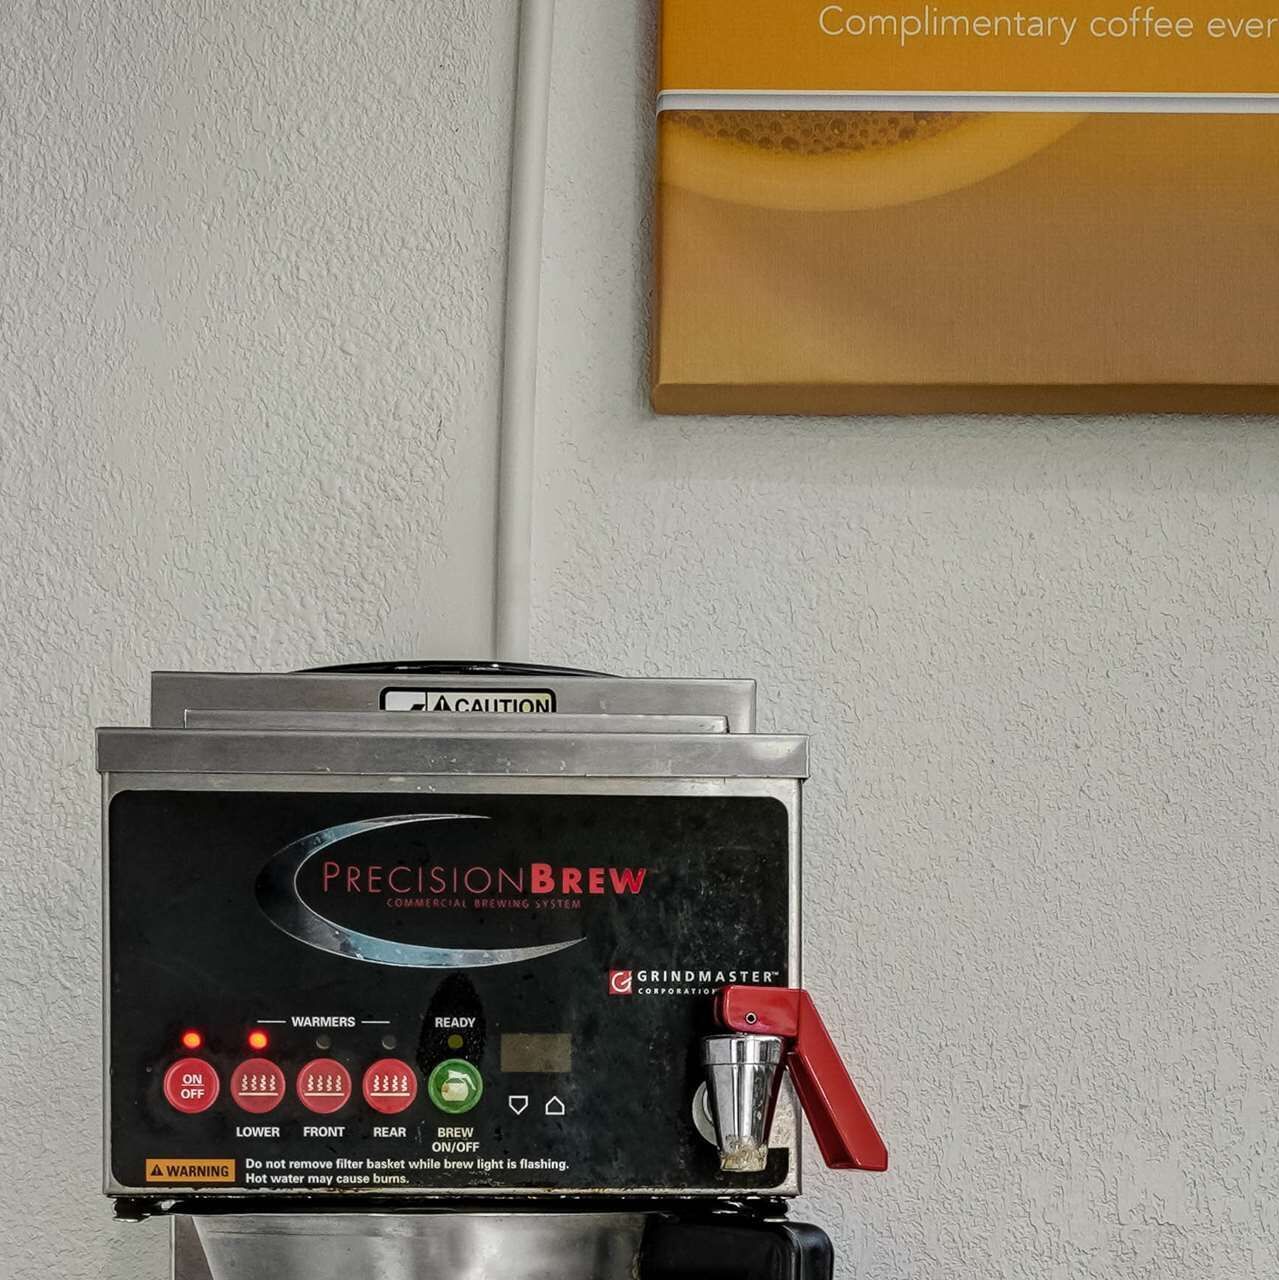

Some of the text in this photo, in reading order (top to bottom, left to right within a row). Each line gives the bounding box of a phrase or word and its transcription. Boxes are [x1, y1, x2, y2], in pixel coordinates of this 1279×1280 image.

[818, 5, 1077, 47] Complimentary
[1089, 6, 1194, 38] coffee
[455, 698, 549, 712] CAUTION
[322, 861, 647, 895] PRECISIONBREW
[386, 898, 581, 910] COMMERCIAL BREWING SYSTEM
[291, 1016, 356, 1028] WARMERS
[434, 1017, 476, 1028] READY
[182, 1074, 202, 1085] ON
[181, 1089, 205, 1100] OFF
[236, 1126, 280, 1138] LOWER
[303, 1126, 345, 1138] FRONT
[373, 1126, 406, 1138] REAR
[437, 1127, 474, 1138] BREW
[431, 1141, 480, 1153] ON/OFF
[166, 1165, 229, 1177] WARNING
[245, 1158, 570, 1172] Do not remove filter basket while brew light is flashing.
[245, 1173, 409, 1187] Hot water may cause burns.
